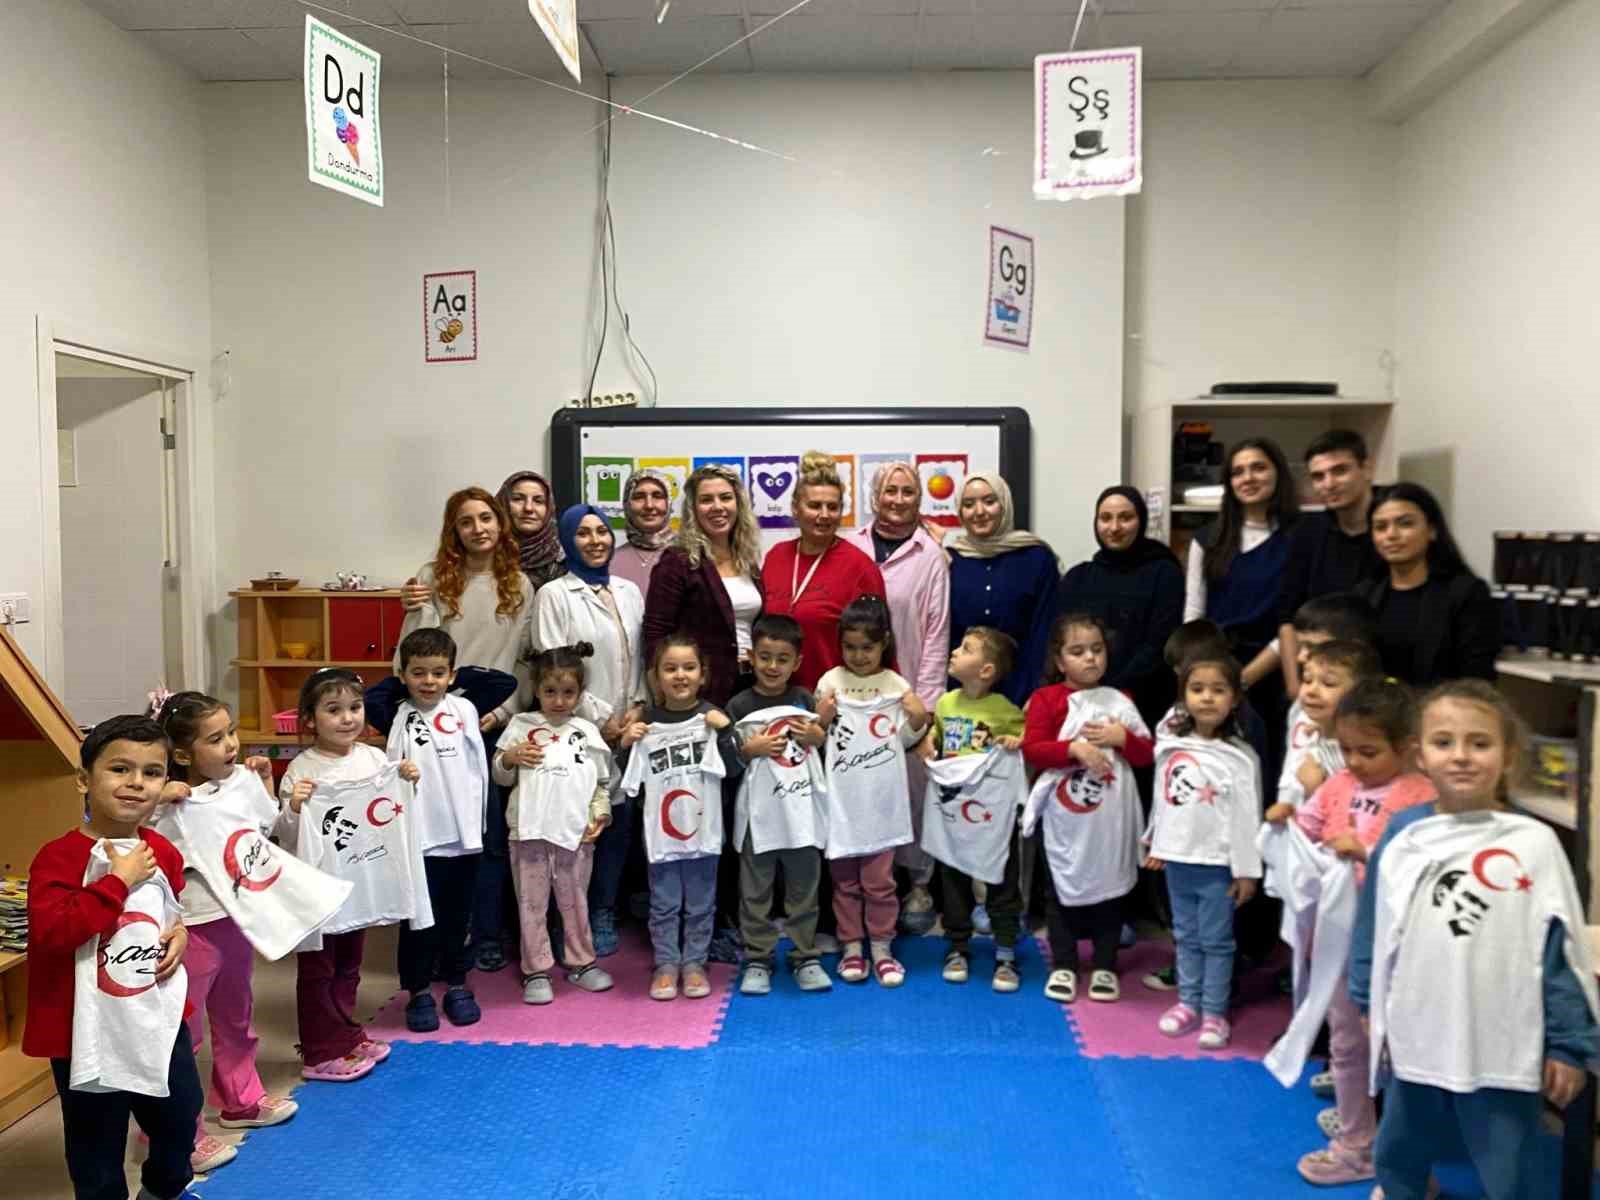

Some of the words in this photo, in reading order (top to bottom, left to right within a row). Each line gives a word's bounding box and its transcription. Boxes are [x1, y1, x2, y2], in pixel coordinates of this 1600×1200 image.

[324, 53, 363, 118] Dd
[1068, 75, 1109, 122] Şş
[433, 284, 466, 313] Aa
